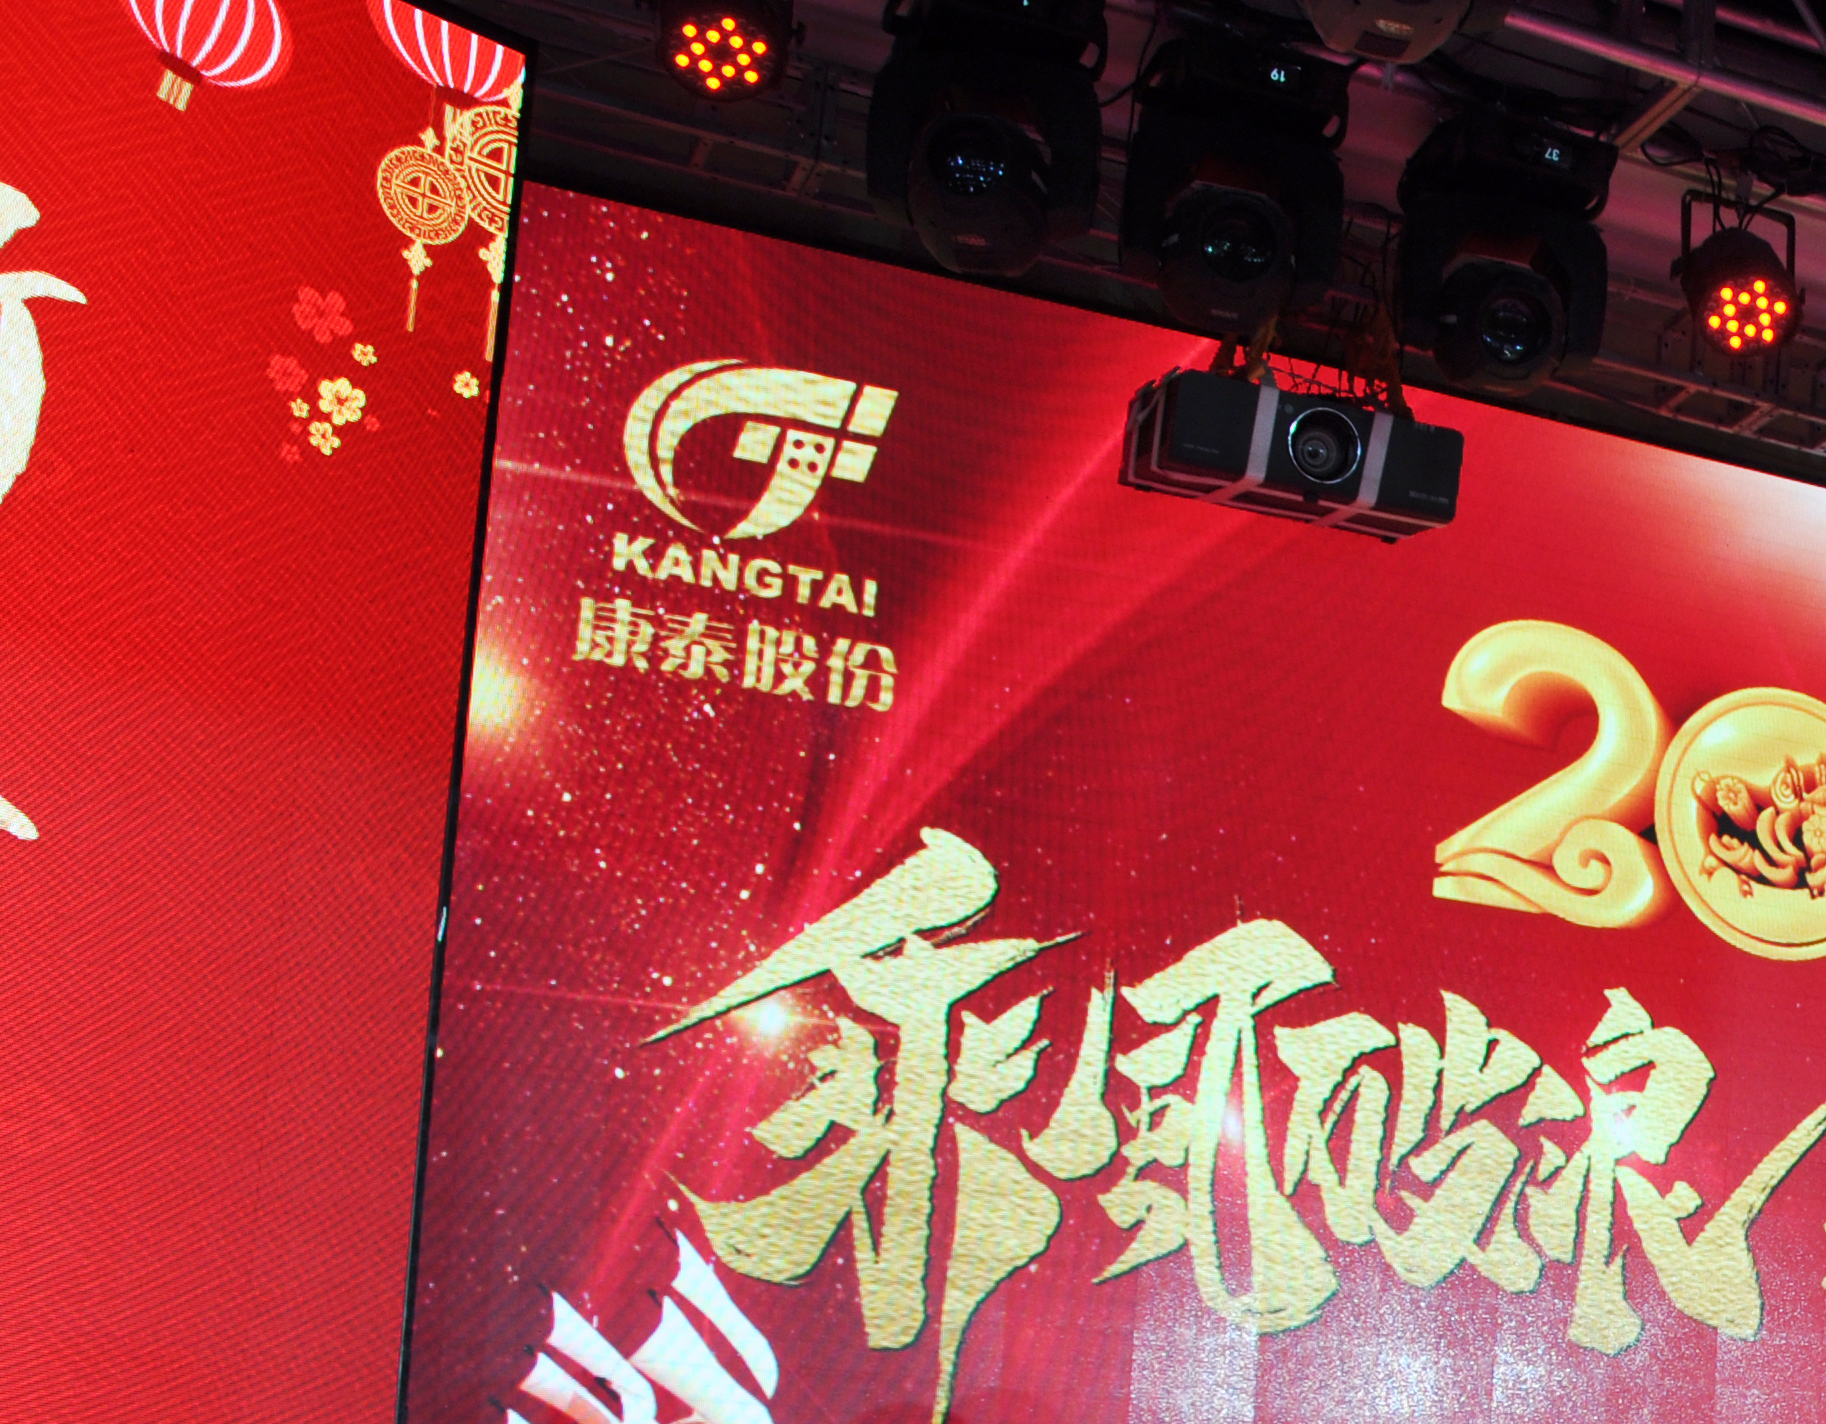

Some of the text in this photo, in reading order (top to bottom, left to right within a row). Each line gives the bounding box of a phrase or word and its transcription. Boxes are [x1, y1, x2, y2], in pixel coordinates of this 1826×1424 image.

[1269, 67, 1287, 83] 19
[1544, 146, 1561, 162] 37
[612, 533, 877, 617] KANGTAI
[572, 596, 898, 712] 康泰股份
